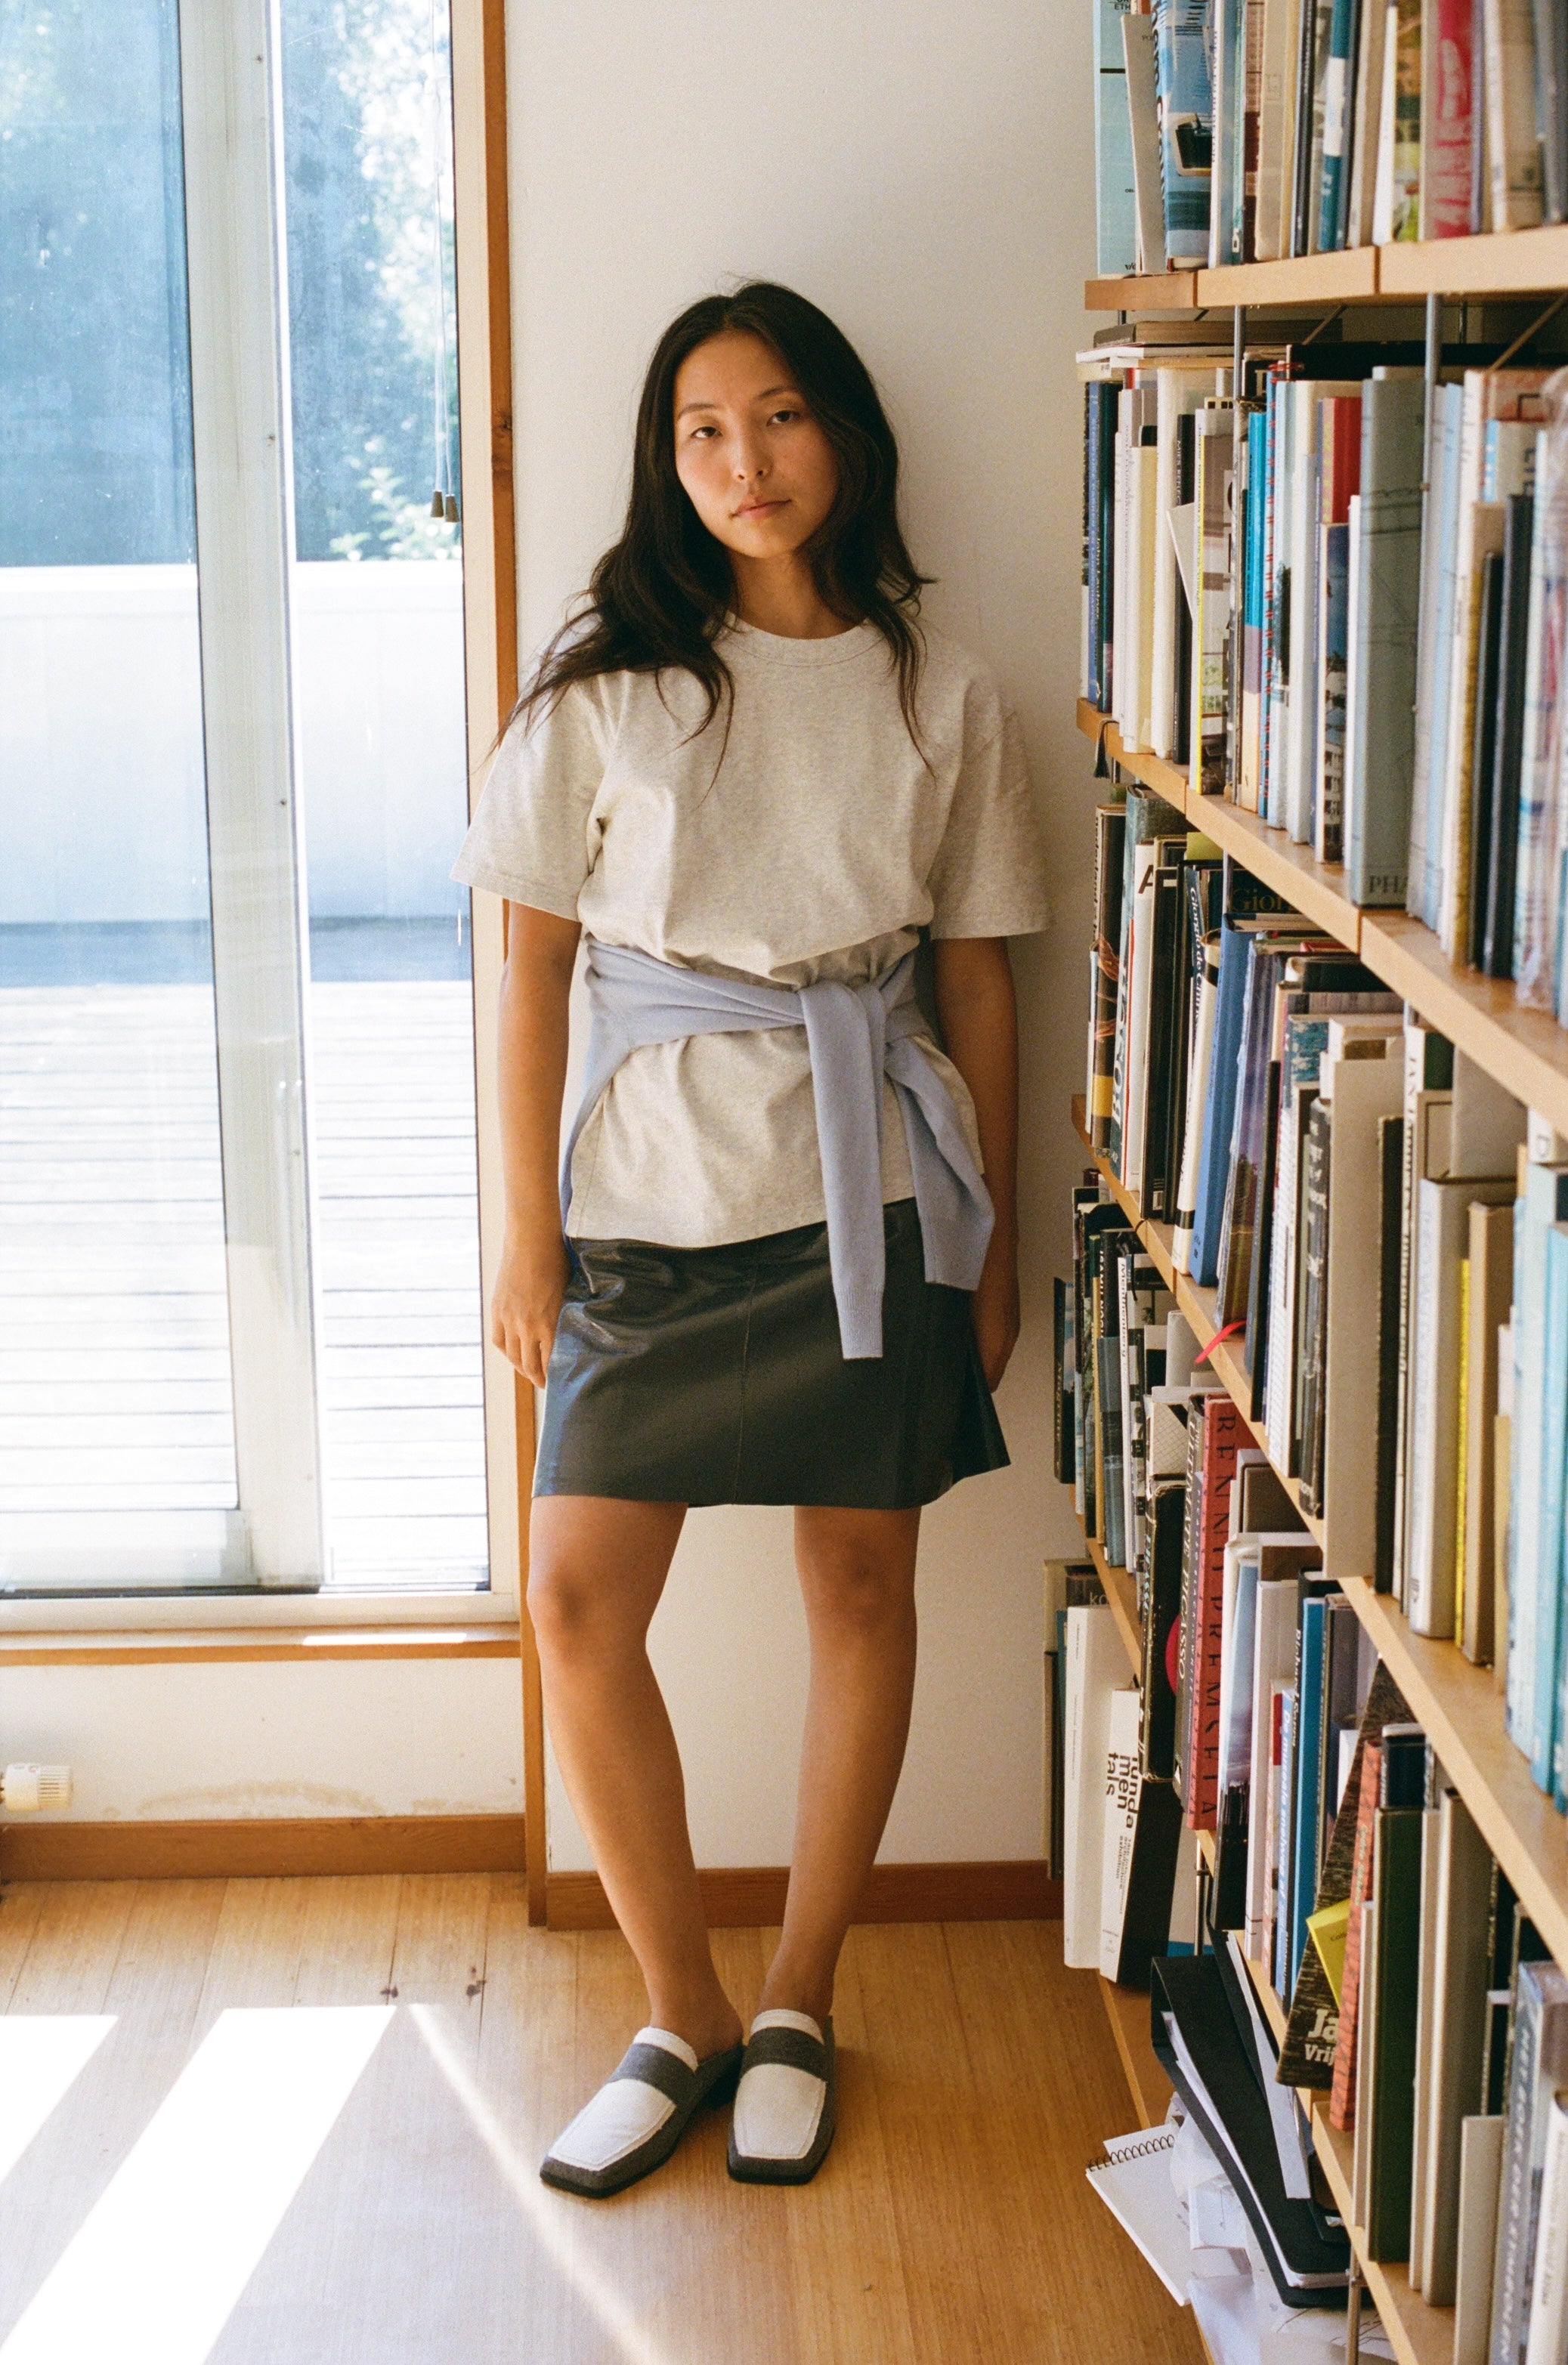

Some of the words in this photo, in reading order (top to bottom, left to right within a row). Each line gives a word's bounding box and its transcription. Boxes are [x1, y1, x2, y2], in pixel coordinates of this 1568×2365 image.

[1183, 1420, 1195, 1558] ULTIMATE
[1178, 1568, 1189, 1679] PICASSO
[1282, 1709, 1291, 1734] De
[1106, 1752, 1118, 1796] tals
[1117, 1755, 1132, 1810] men
[1281, 1736, 1289, 1806] museale
